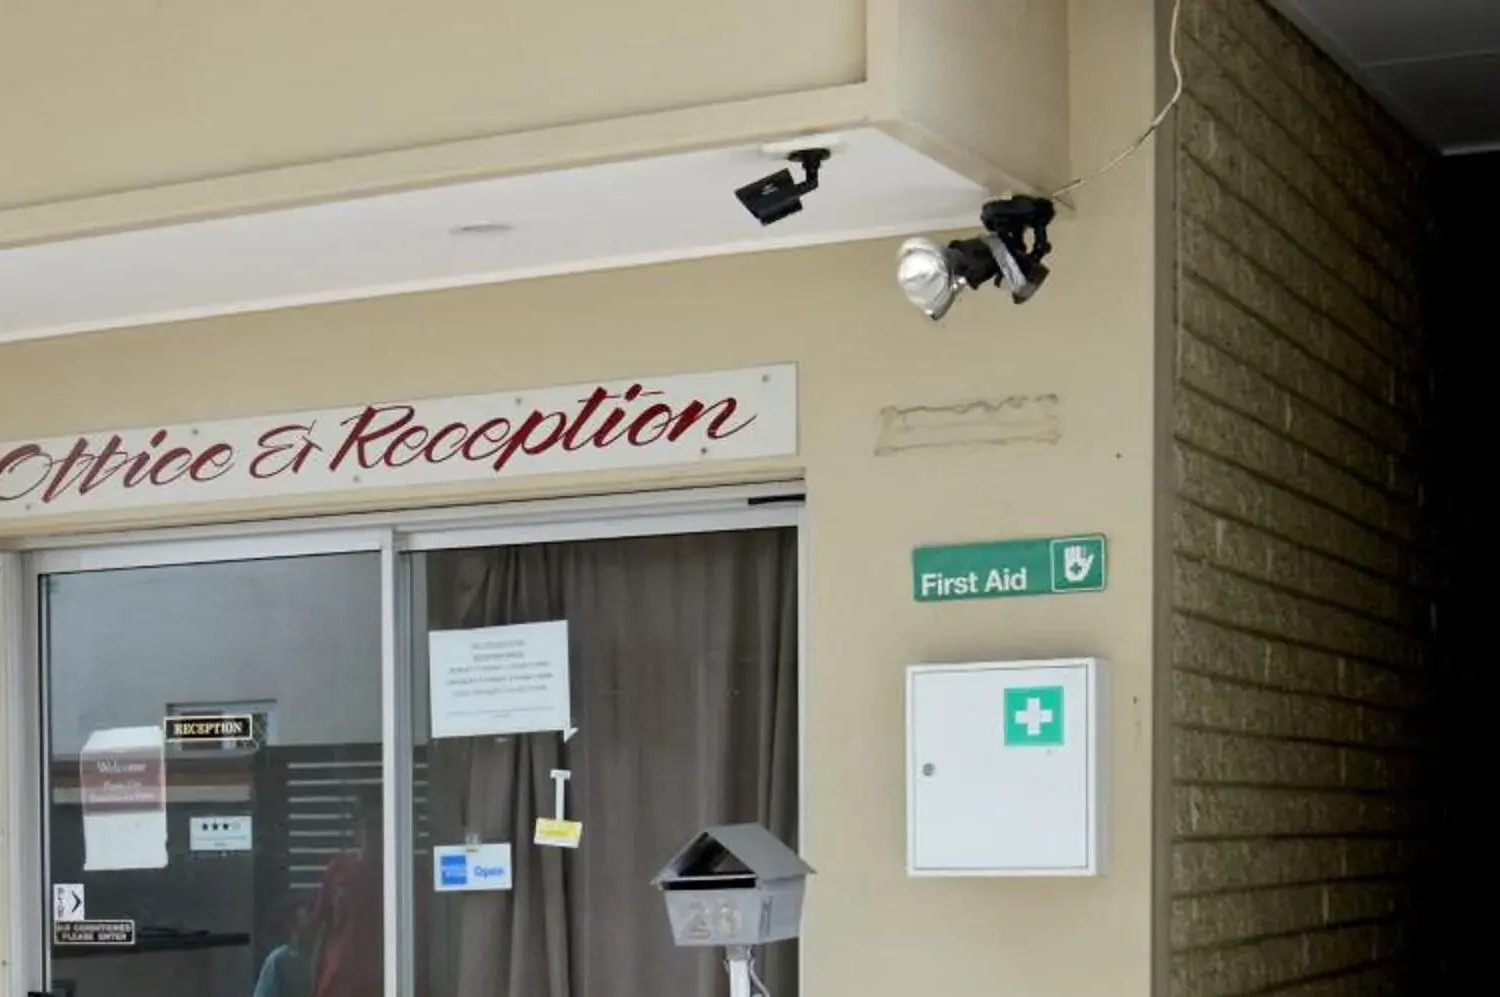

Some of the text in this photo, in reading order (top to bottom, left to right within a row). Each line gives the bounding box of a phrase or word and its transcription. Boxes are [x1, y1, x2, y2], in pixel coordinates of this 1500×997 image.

[250, 419, 323, 479] &
[329, 383, 758, 472] Reception
[920, 566, 1028, 596] First Aid
[173, 721, 243, 735] RECEPTION
[473, 865, 505, 879] Open
